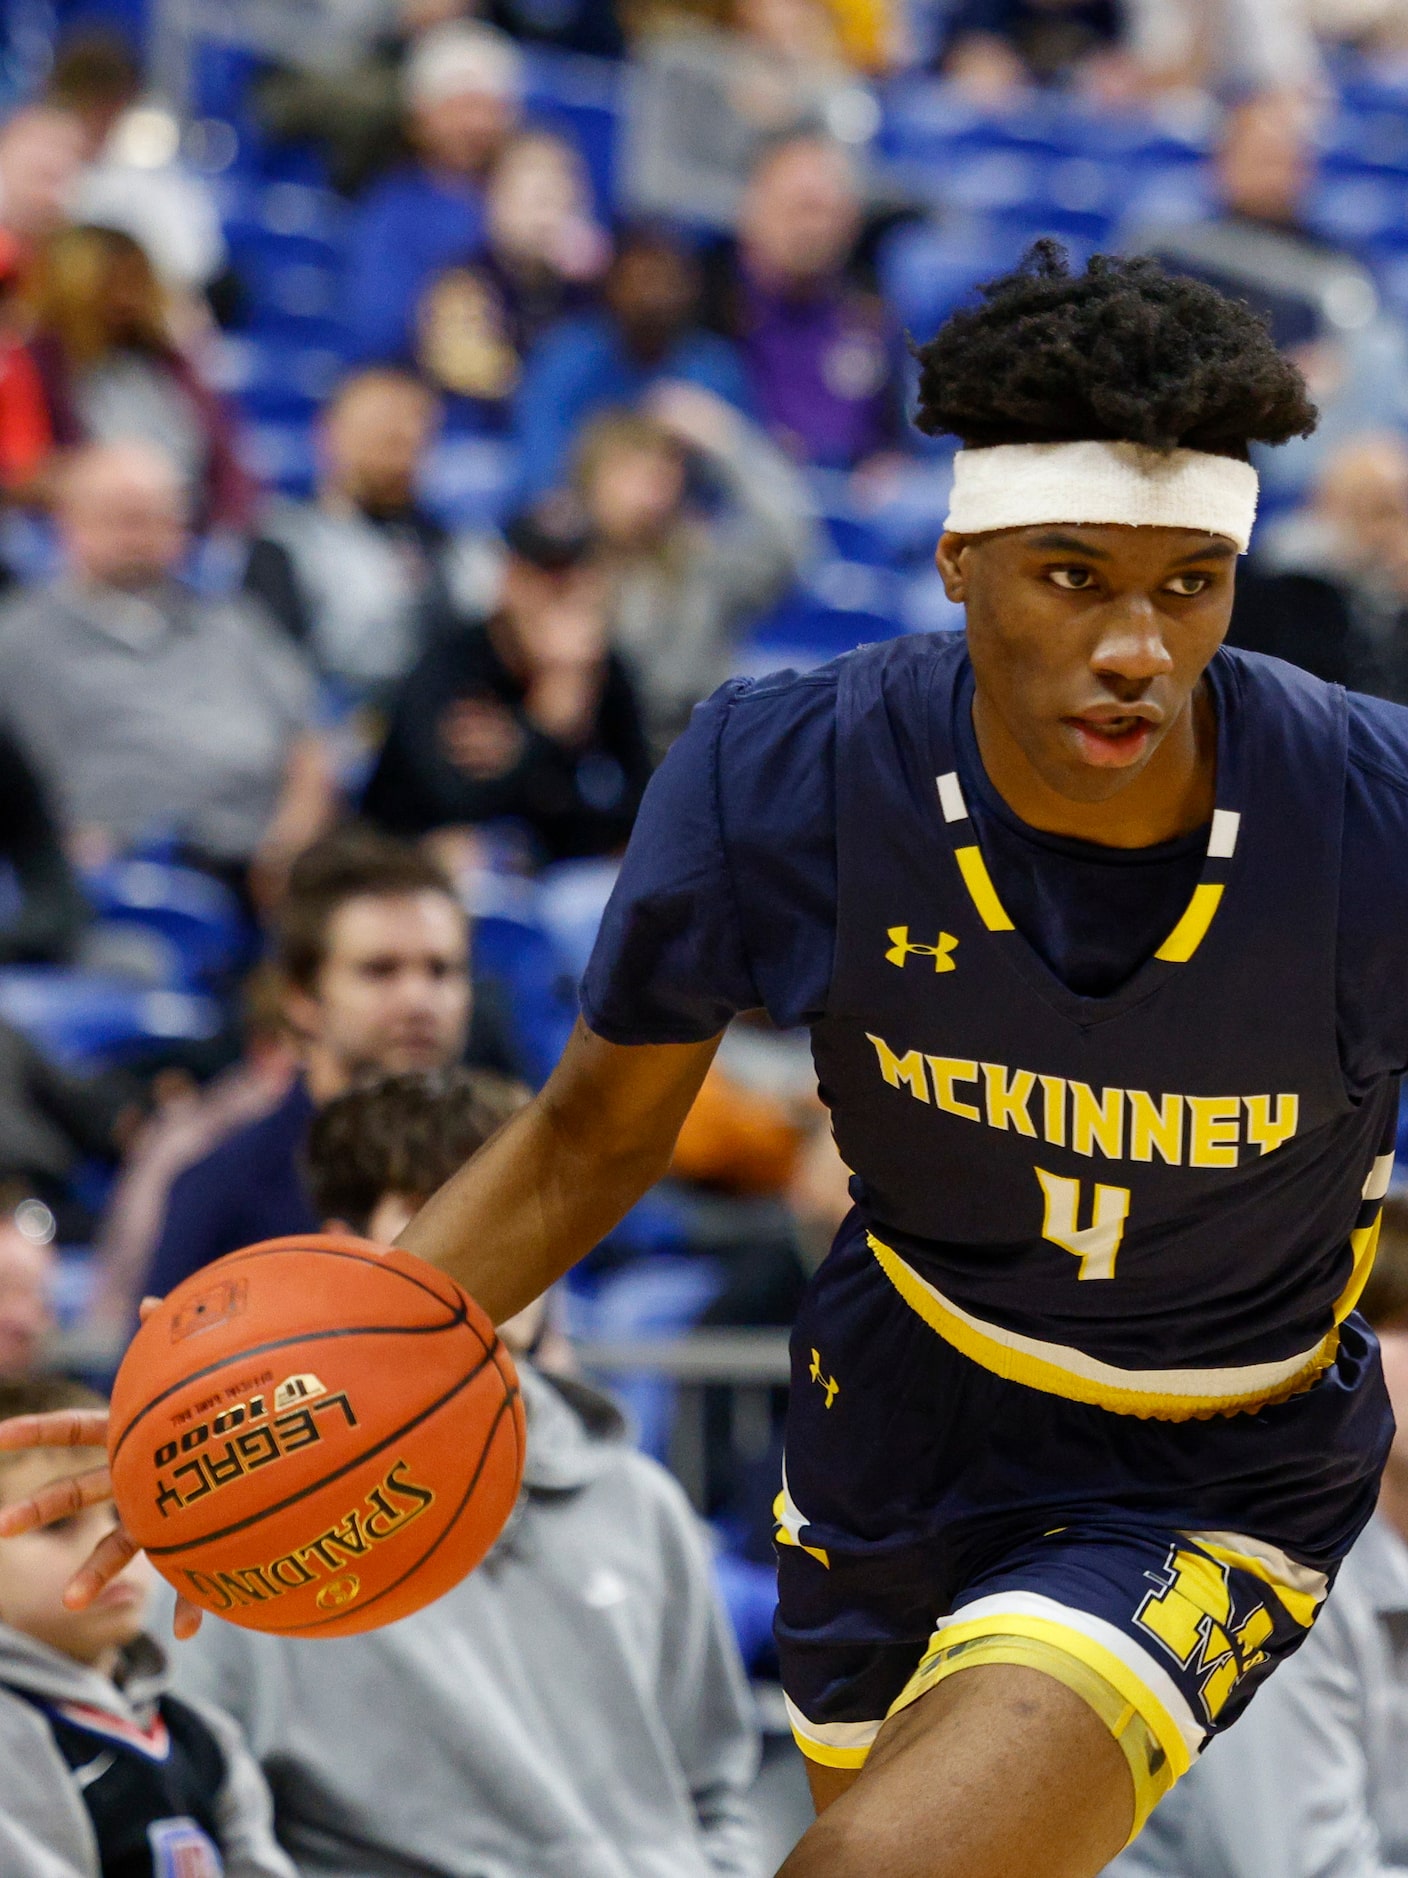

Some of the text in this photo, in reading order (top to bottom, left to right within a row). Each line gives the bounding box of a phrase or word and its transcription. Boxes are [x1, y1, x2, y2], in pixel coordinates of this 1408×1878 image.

[865, 1032, 1298, 1168] MCKINNEY
[1034, 1166, 1130, 1280] 4
[154, 1394, 268, 1468] 1000
[155, 1391, 359, 1518] LEGACY
[183, 1458, 435, 1610] SPALDING
